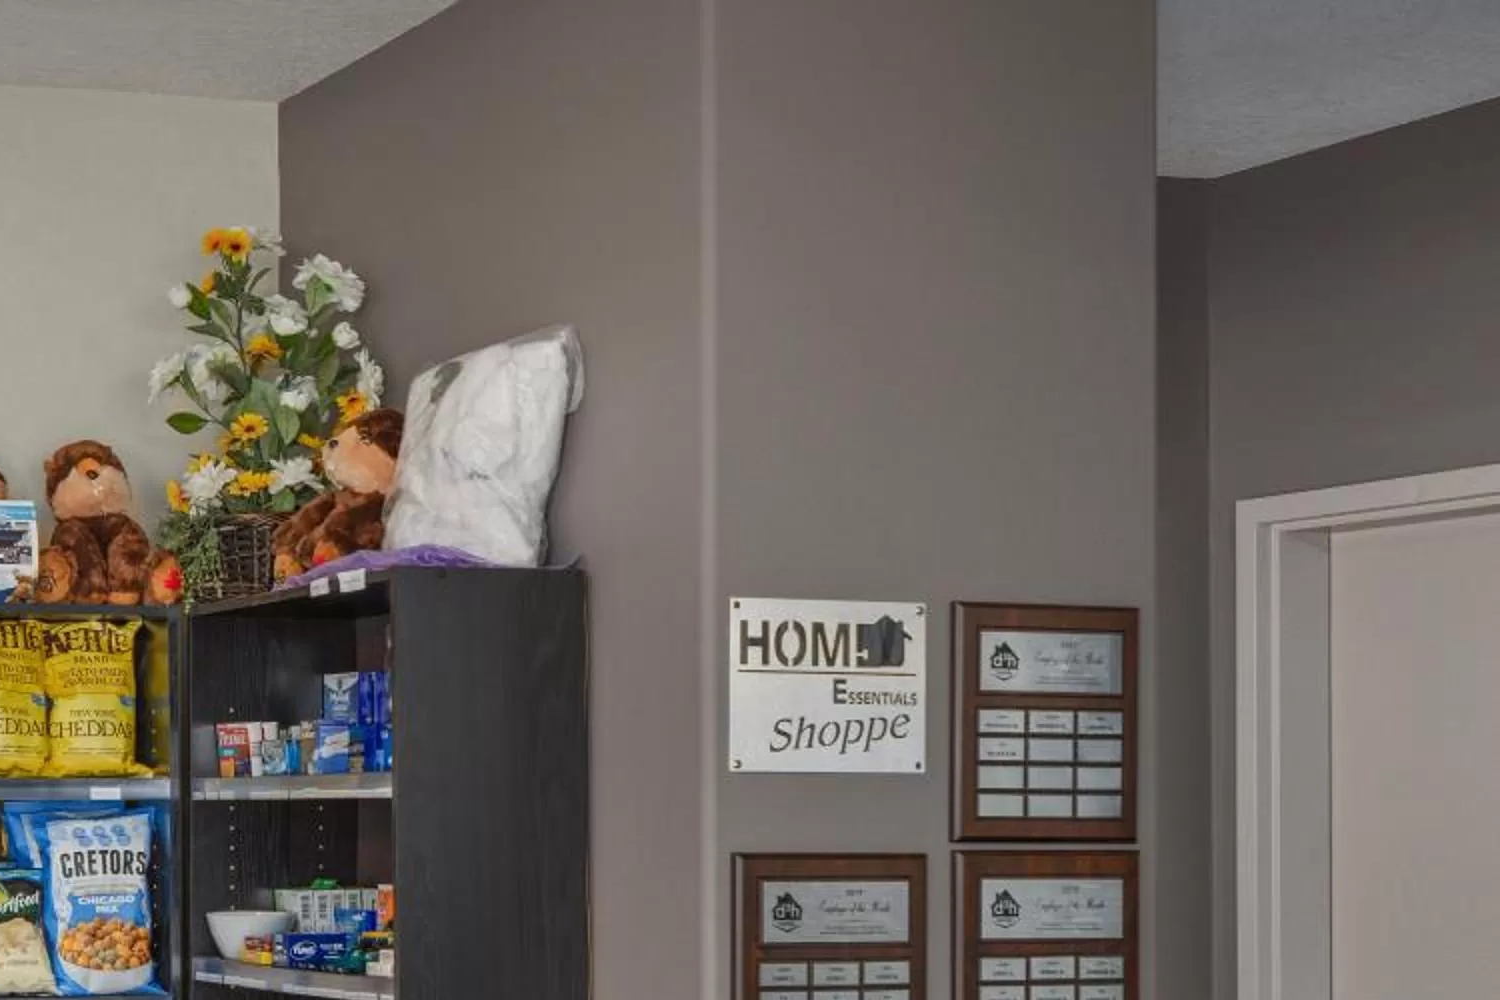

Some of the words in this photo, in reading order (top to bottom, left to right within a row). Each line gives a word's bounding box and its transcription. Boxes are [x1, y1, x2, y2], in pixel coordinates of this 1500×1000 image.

[833, 678, 917, 705] ESSENTIALS
[769, 713, 911, 755] Shoppe
[60, 850, 148, 879] CRETORS
[78, 895, 135, 905] CHICAGO
